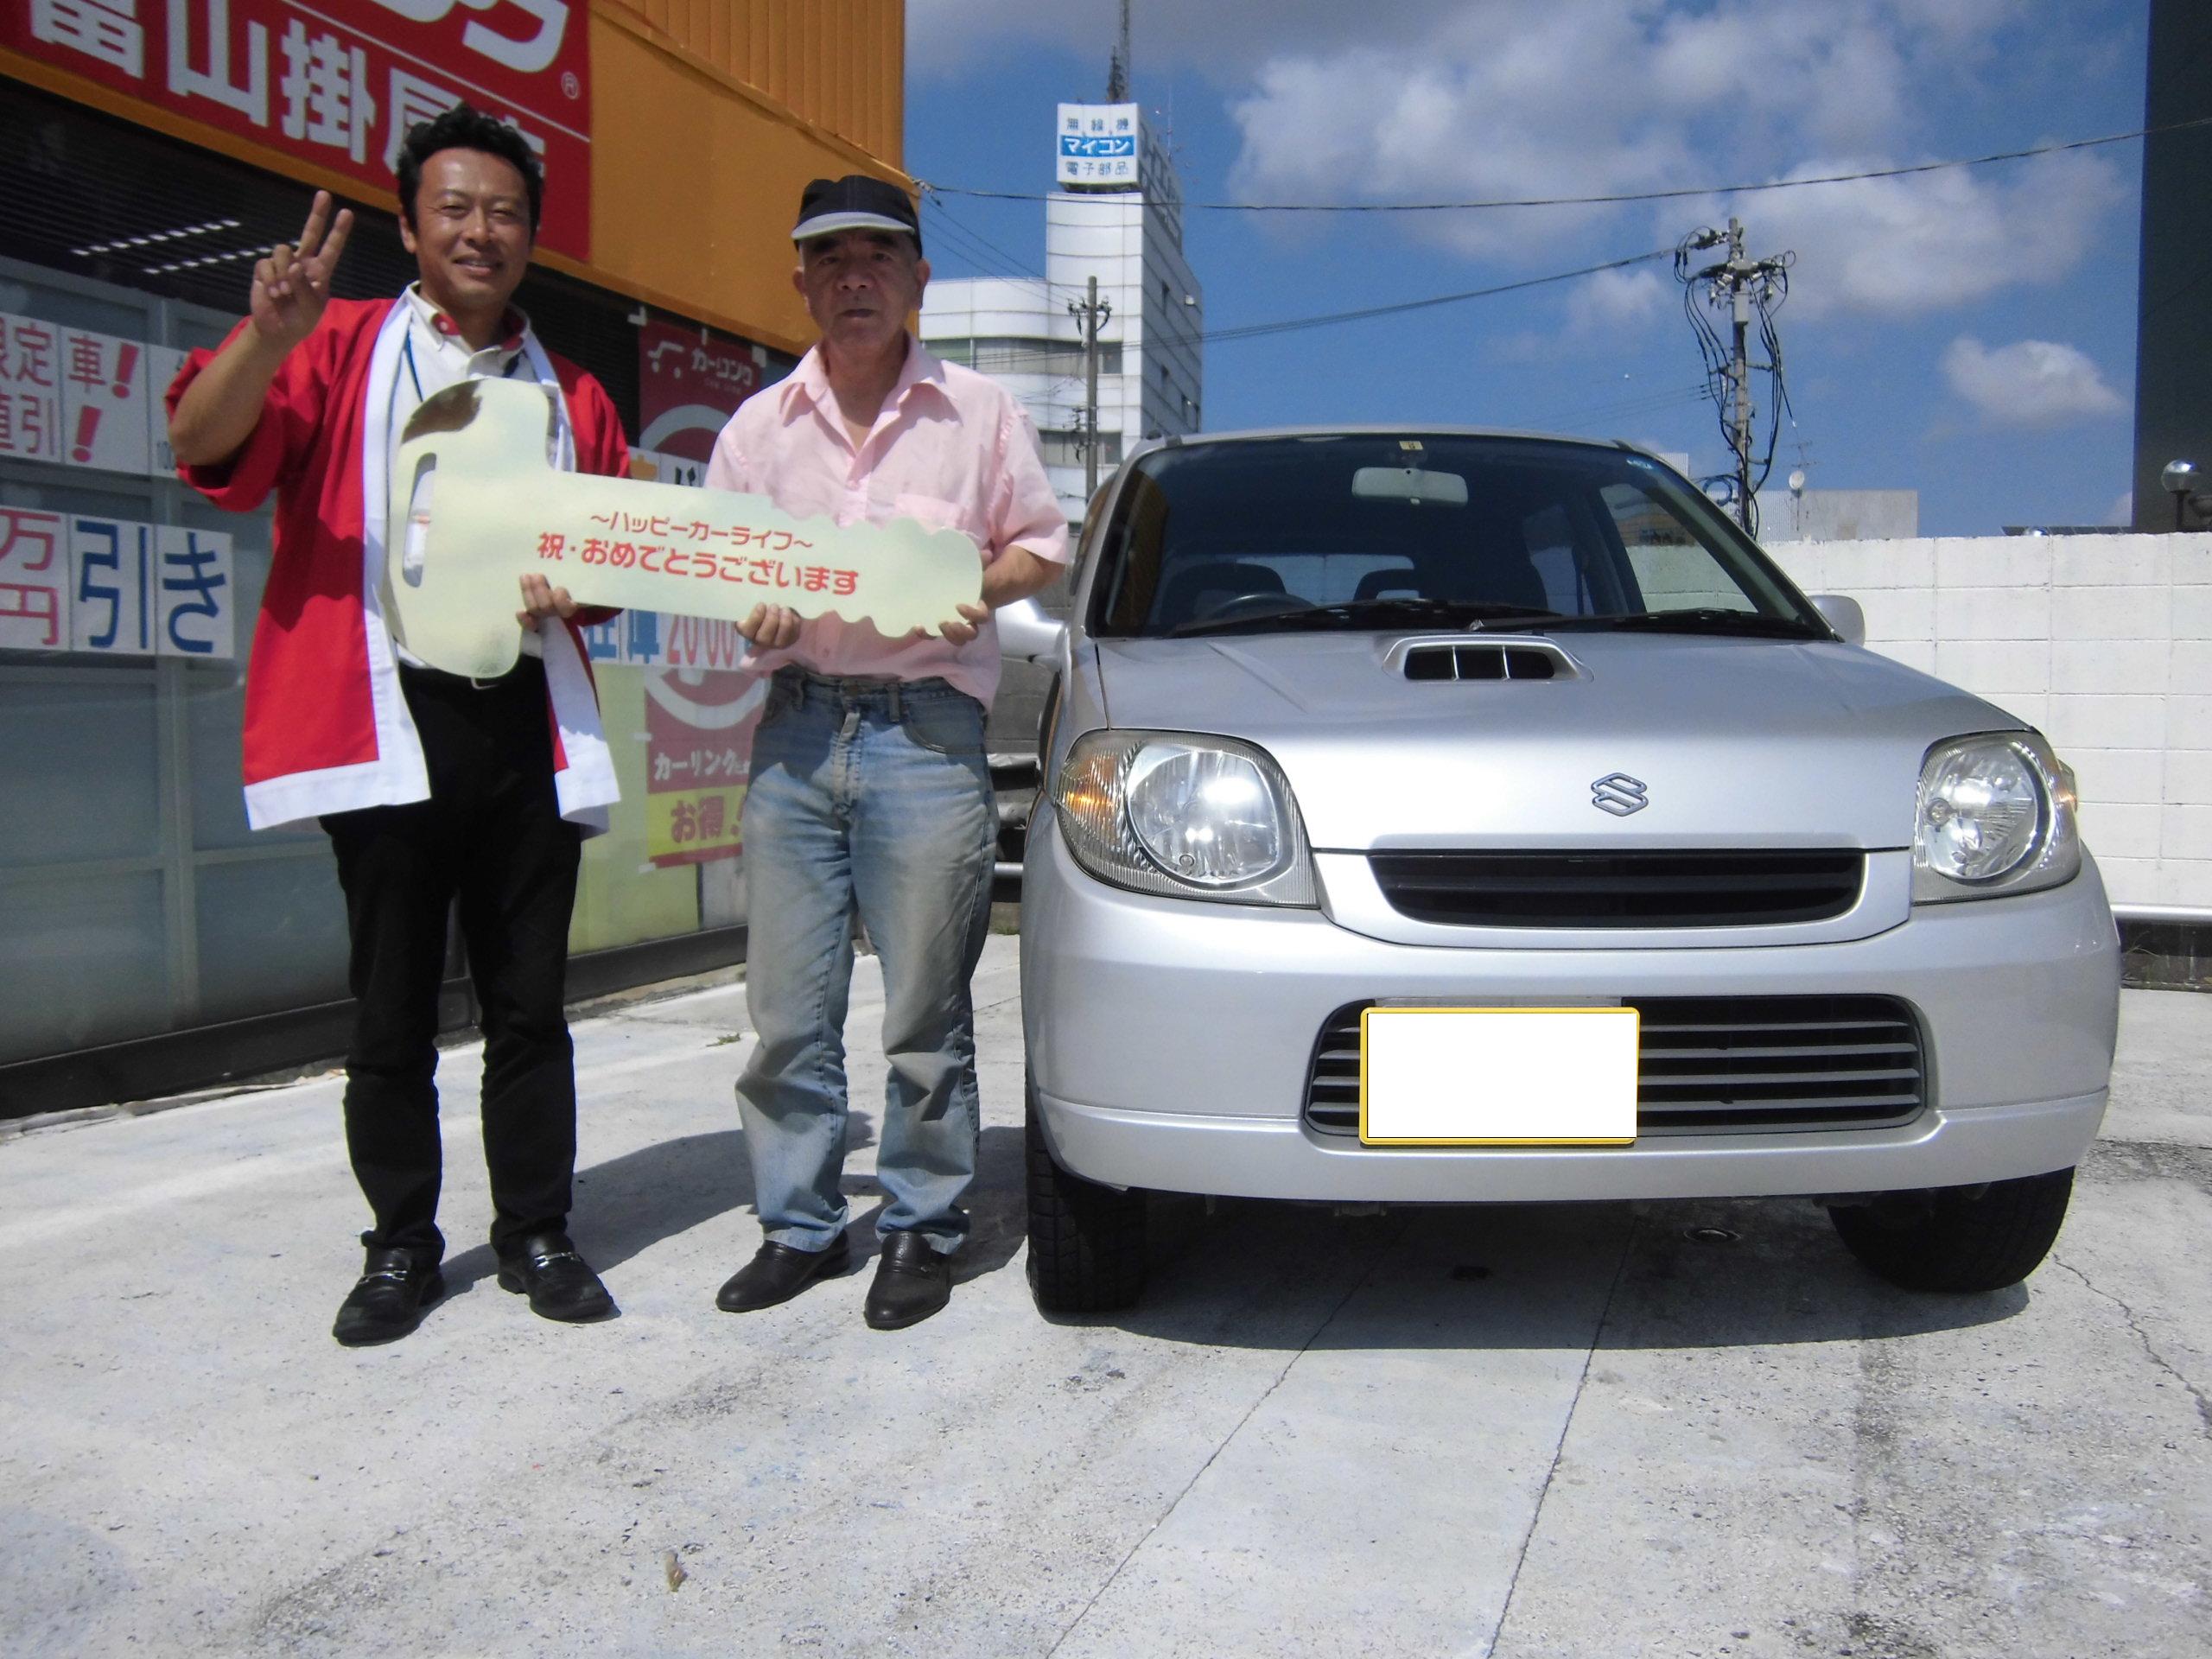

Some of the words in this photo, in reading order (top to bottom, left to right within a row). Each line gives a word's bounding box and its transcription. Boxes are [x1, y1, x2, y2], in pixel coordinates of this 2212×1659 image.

[1064, 137, 1131, 155] マイコン
[1065, 161, 1128, 175] 電子部品
